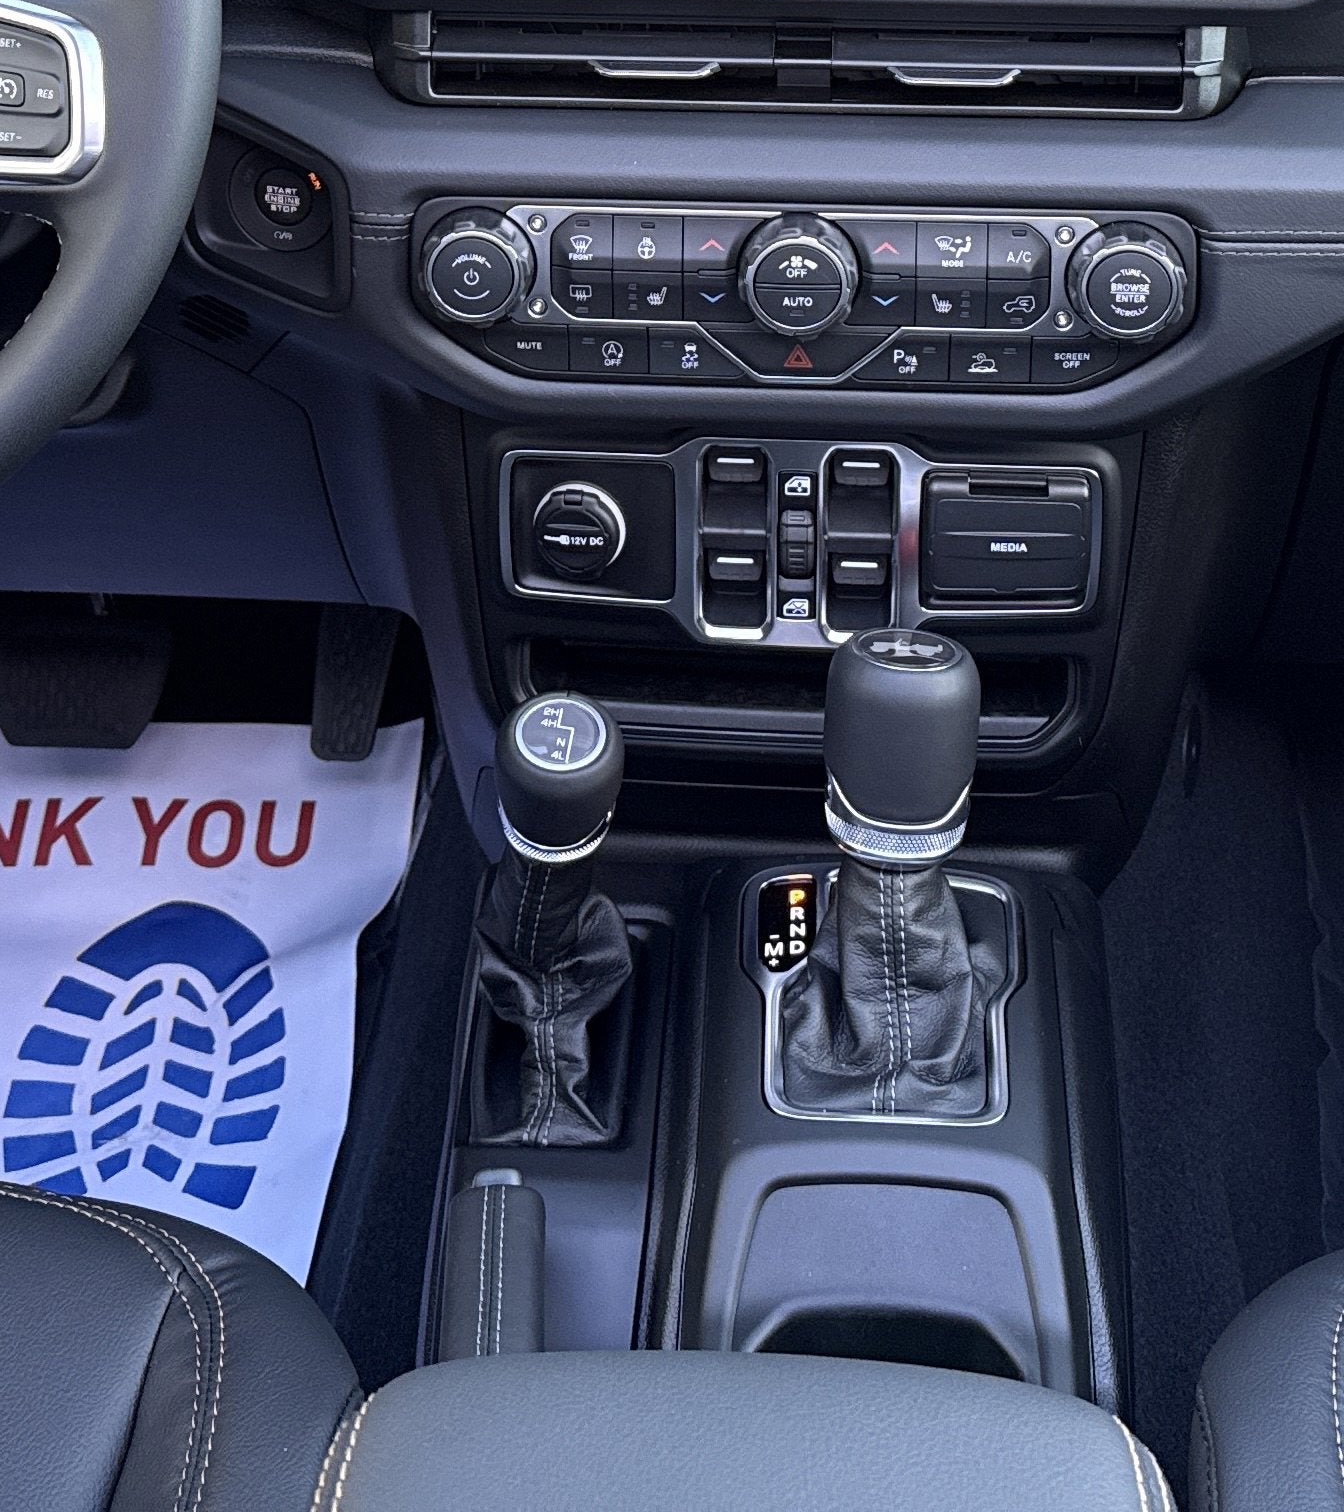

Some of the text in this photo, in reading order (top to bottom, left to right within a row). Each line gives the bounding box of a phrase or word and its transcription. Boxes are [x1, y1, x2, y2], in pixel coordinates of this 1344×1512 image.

[37, 89, 53, 99] RES
[266, 185, 298, 195] START
[265, 194, 300, 206] ENGINE
[270, 204, 298, 213] STOP
[455, 253, 488, 265] VOLUME
[569, 252, 594, 261] FRONT
[1006, 250, 1032, 264] A/C
[787, 268, 807, 279] OFF
[1111, 283, 1150, 291] BROWSE
[783, 296, 813, 307] AUTO
[1116, 294, 1146, 303] ENTER
[517, 341, 542, 351] MUTE
[1054, 352, 1090, 361] SCREEN
[604, 358, 621, 367] OFF
[681, 360, 699, 370] OFF
[1063, 360, 1080, 369] OFF
[898, 365, 916, 374] OFF
[570, 536, 604, 546] 12V DC
[990, 541, 1028, 553] MEDIA
[544, 707, 559, 716] 2H
[540, 718, 557, 728] 4H
[556, 737, 566, 747] N
[551, 750, 564, 760] 4L
[132, 798, 317, 868] YOU
[789, 890, 805, 904] P
[790, 907, 805, 920] R
[789, 923, 806, 937] N
[764, 941, 784, 956] M
[789, 941, 806, 955] D
